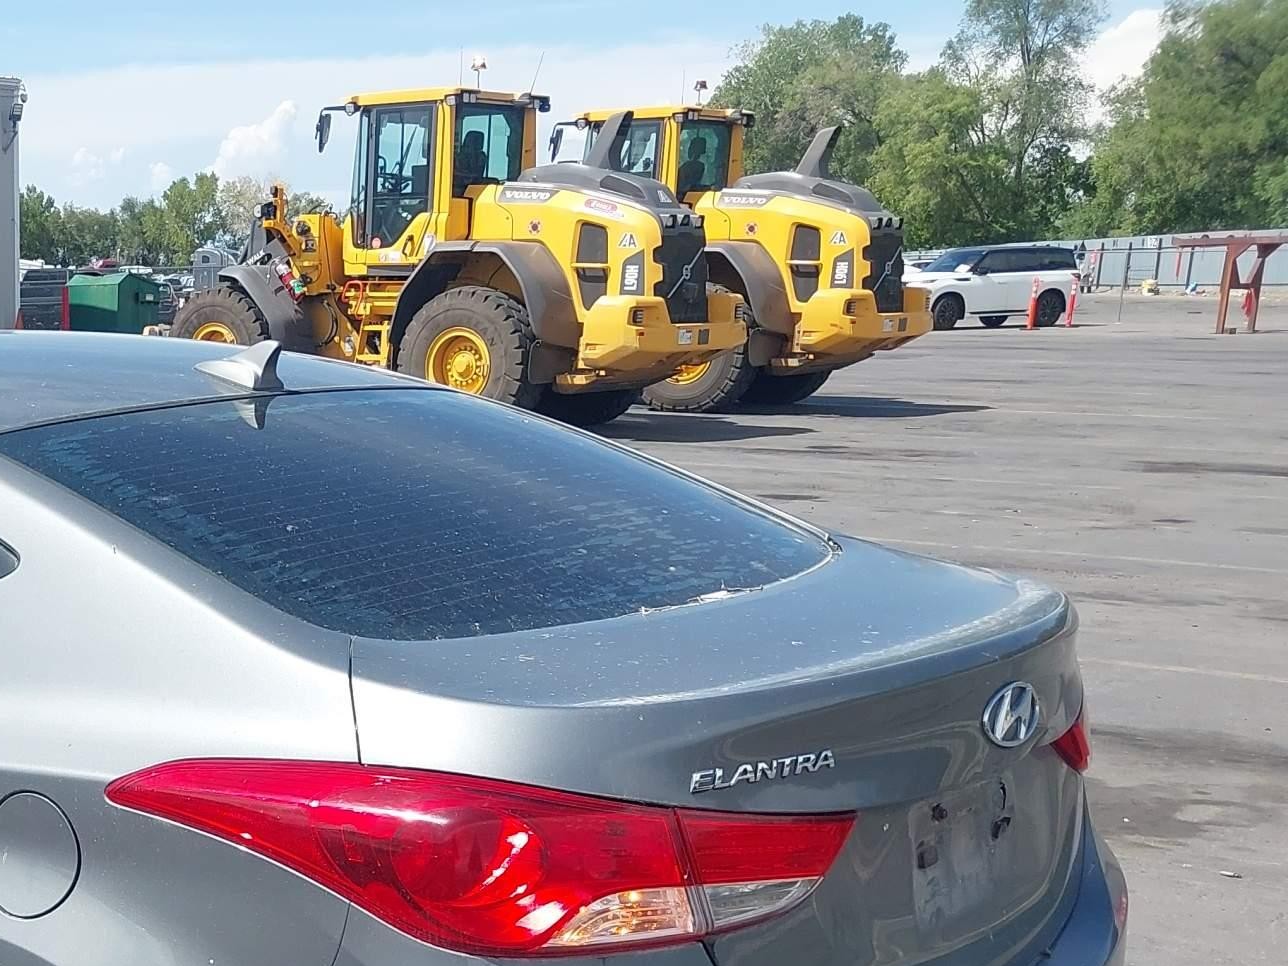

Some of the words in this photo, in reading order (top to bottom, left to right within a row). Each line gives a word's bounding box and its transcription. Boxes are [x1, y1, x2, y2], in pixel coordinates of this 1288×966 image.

[504, 190, 550, 200] VOLVO
[723, 196, 768, 205] VOLVO
[623, 264, 640, 291] L90H
[833, 261, 849, 285] L90H
[689, 749, 836, 794] ELANTRA
